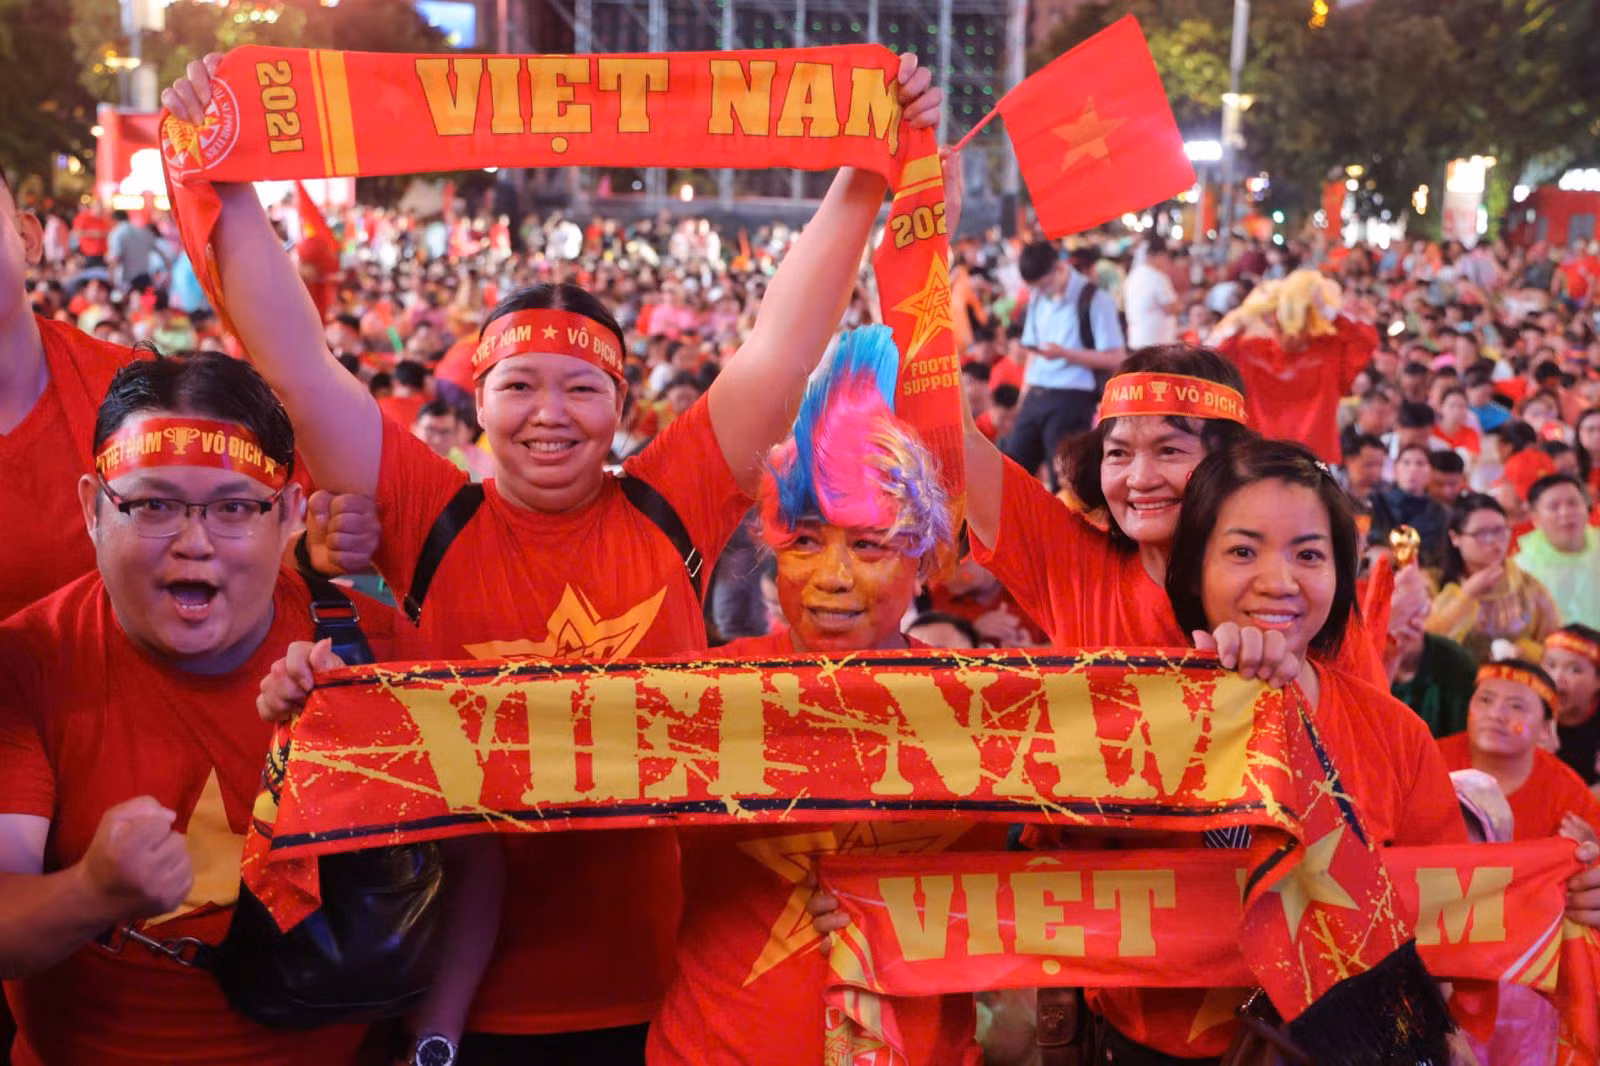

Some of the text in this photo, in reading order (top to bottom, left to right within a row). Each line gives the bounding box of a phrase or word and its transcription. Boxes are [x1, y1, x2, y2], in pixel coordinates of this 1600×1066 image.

[255, 60, 304, 154] 2021
[707, 58, 901, 156] NAM
[891, 201, 947, 250] 202
[500, 324, 532, 348] NAM
[567, 327, 589, 349] VÔ
[593, 336, 616, 365] ĐỊCH
[1111, 384, 1237, 415] NAM VÔ ĐỊCH
[127, 431, 162, 459] NAM
[202, 430, 225, 454] VÔ
[228, 436, 263, 467] ĐỊCH
[868, 671, 1281, 801] NAM
[878, 856, 1176, 975] VIỆT
